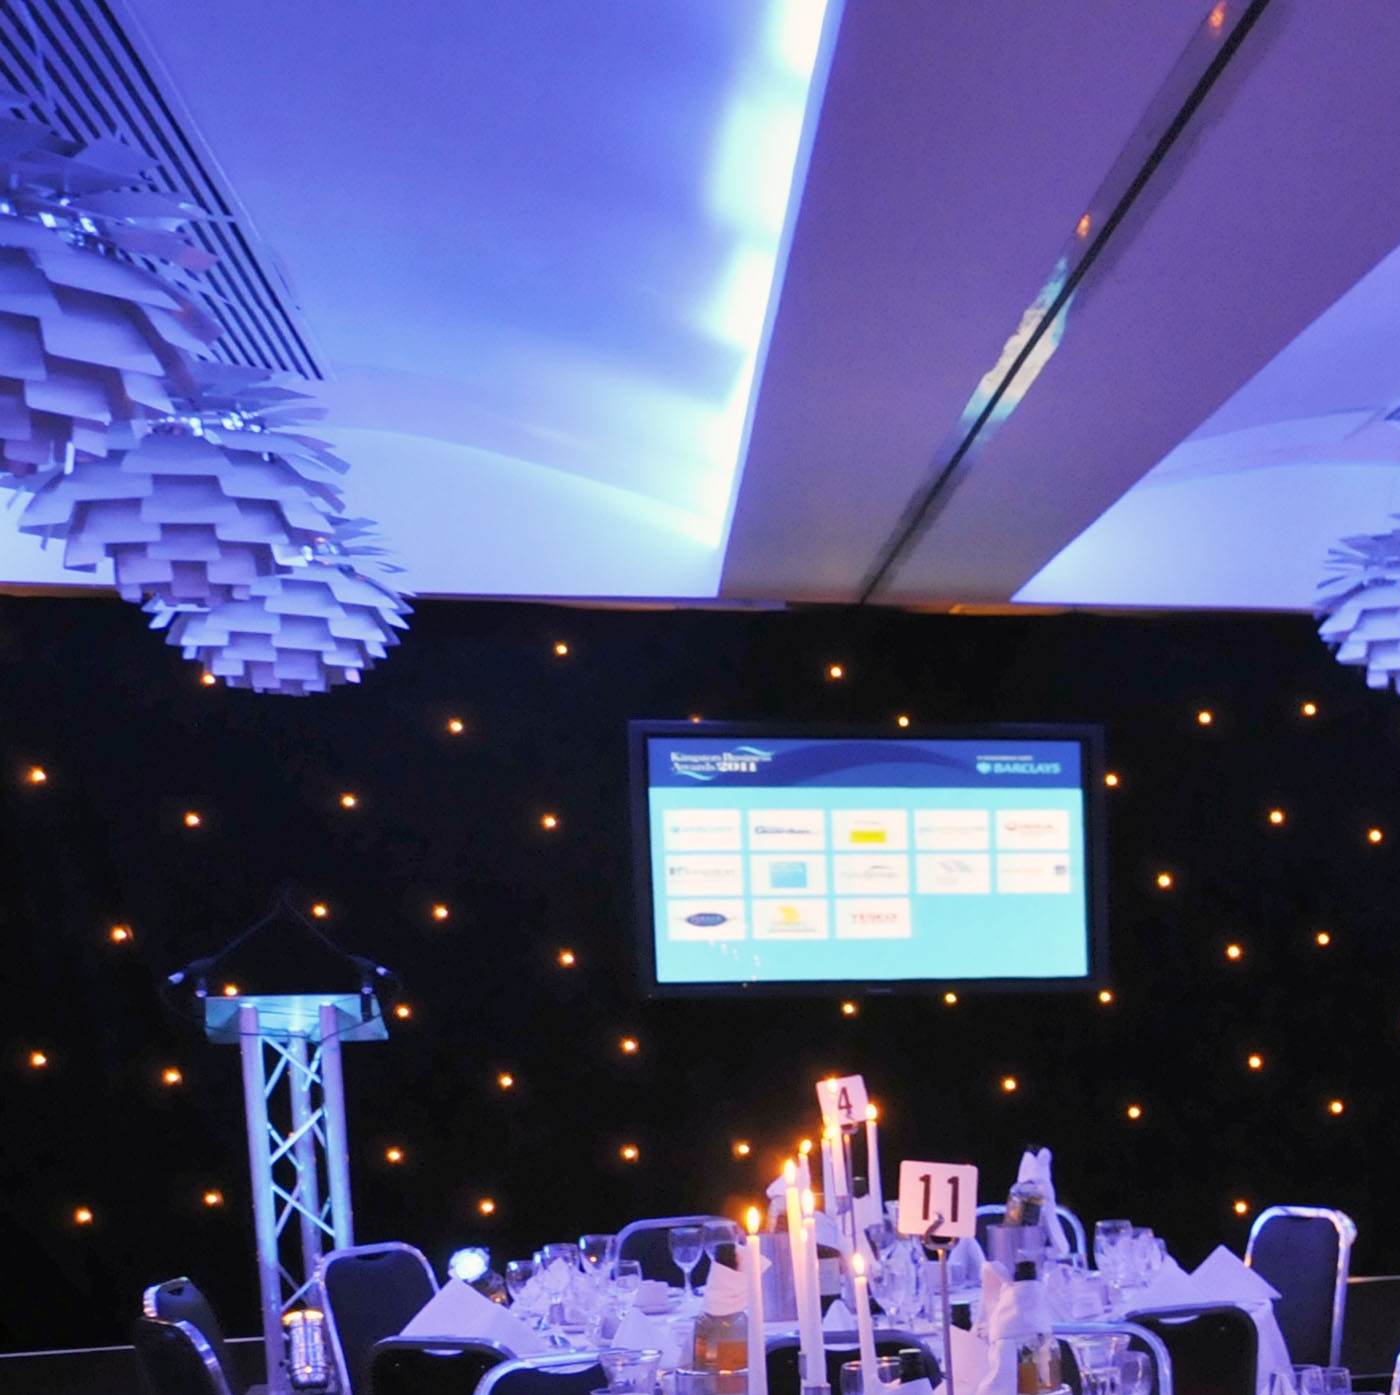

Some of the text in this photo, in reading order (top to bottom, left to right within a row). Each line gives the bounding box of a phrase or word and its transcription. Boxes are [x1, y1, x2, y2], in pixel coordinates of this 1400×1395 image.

[717, 761, 757, 773] 2011
[993, 762, 1061, 775] BARCLAYS
[836, 1086, 854, 1112] 4
[918, 1173, 960, 1223] 11
